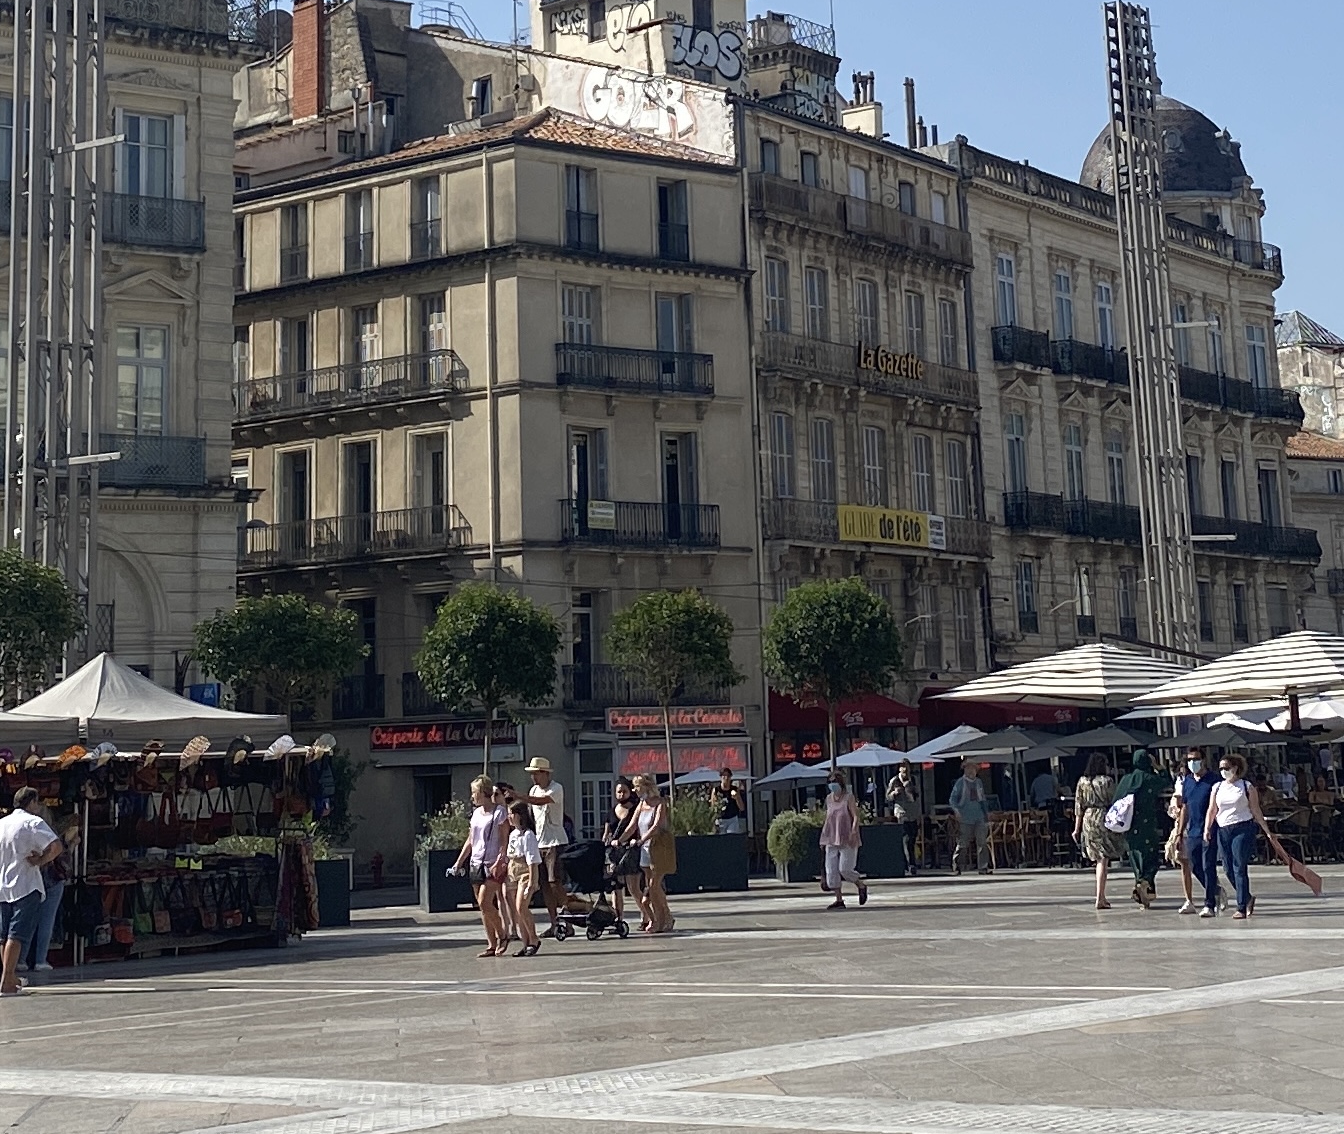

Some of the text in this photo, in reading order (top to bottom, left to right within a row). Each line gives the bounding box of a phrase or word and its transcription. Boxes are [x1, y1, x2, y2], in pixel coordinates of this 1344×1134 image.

[858, 341, 924, 380] La Gazette
[844, 510, 876, 539] GUIDE
[879, 513, 894, 540] de
[896, 515, 922, 543] l'été
[426, 724, 443, 742] de
[446, 723, 461, 742] la
